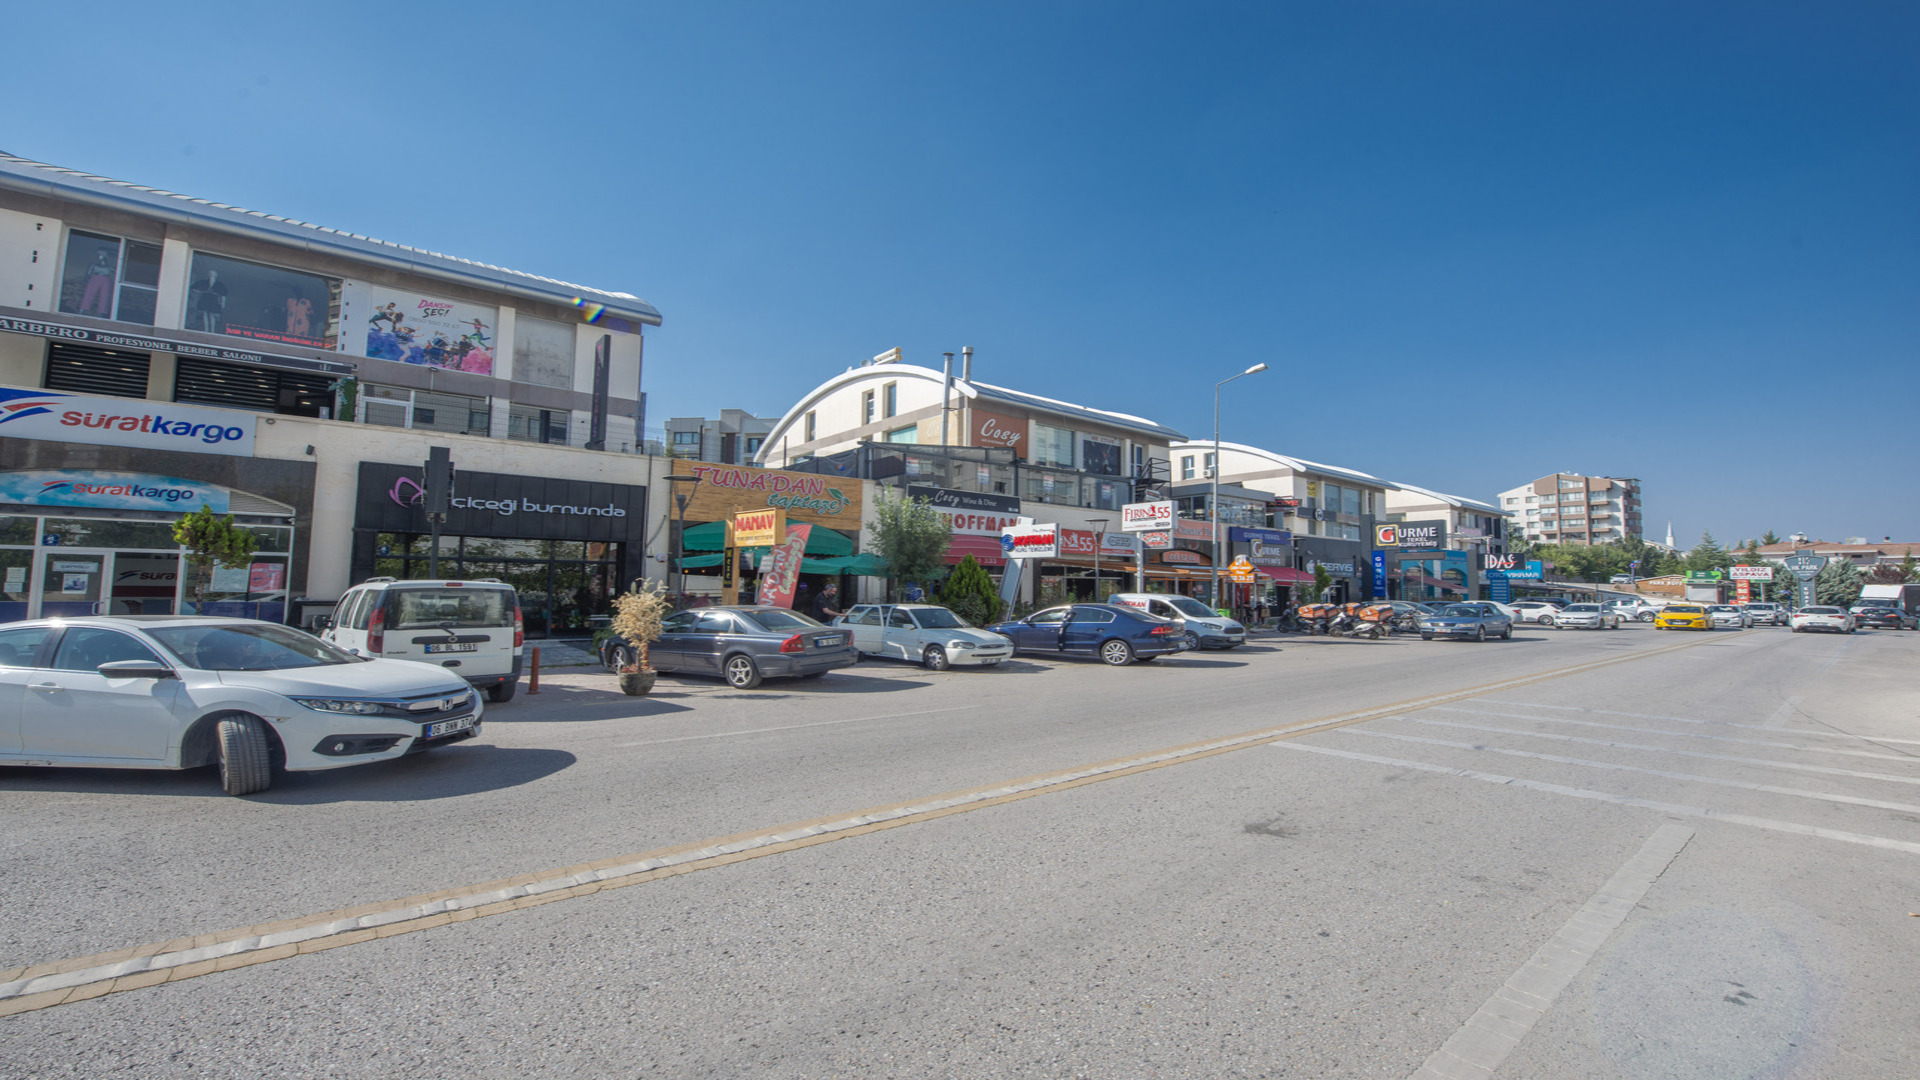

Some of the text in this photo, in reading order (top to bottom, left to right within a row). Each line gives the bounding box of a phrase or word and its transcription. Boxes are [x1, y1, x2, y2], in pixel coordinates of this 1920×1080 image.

[96, 334, 173, 350] PROFESYONEL
[177, 344, 218, 357] BERBER
[222, 351, 262, 362] SALONU
[60, 410, 243, 444] süratkargo
[980, 418, 1021, 447] Cosy
[692, 466, 824, 495] TUNA'DAN
[72, 483, 194, 502] süratkargo
[522, 497, 626, 517] burnunda
[767, 492, 839, 515] taptaze
[736, 514, 775, 532] MANAV
[1124, 506, 1171, 522] FIRIN 55
[1014, 534, 1054, 547] HOFFMAN
[1079, 536, 1093, 552] 55
